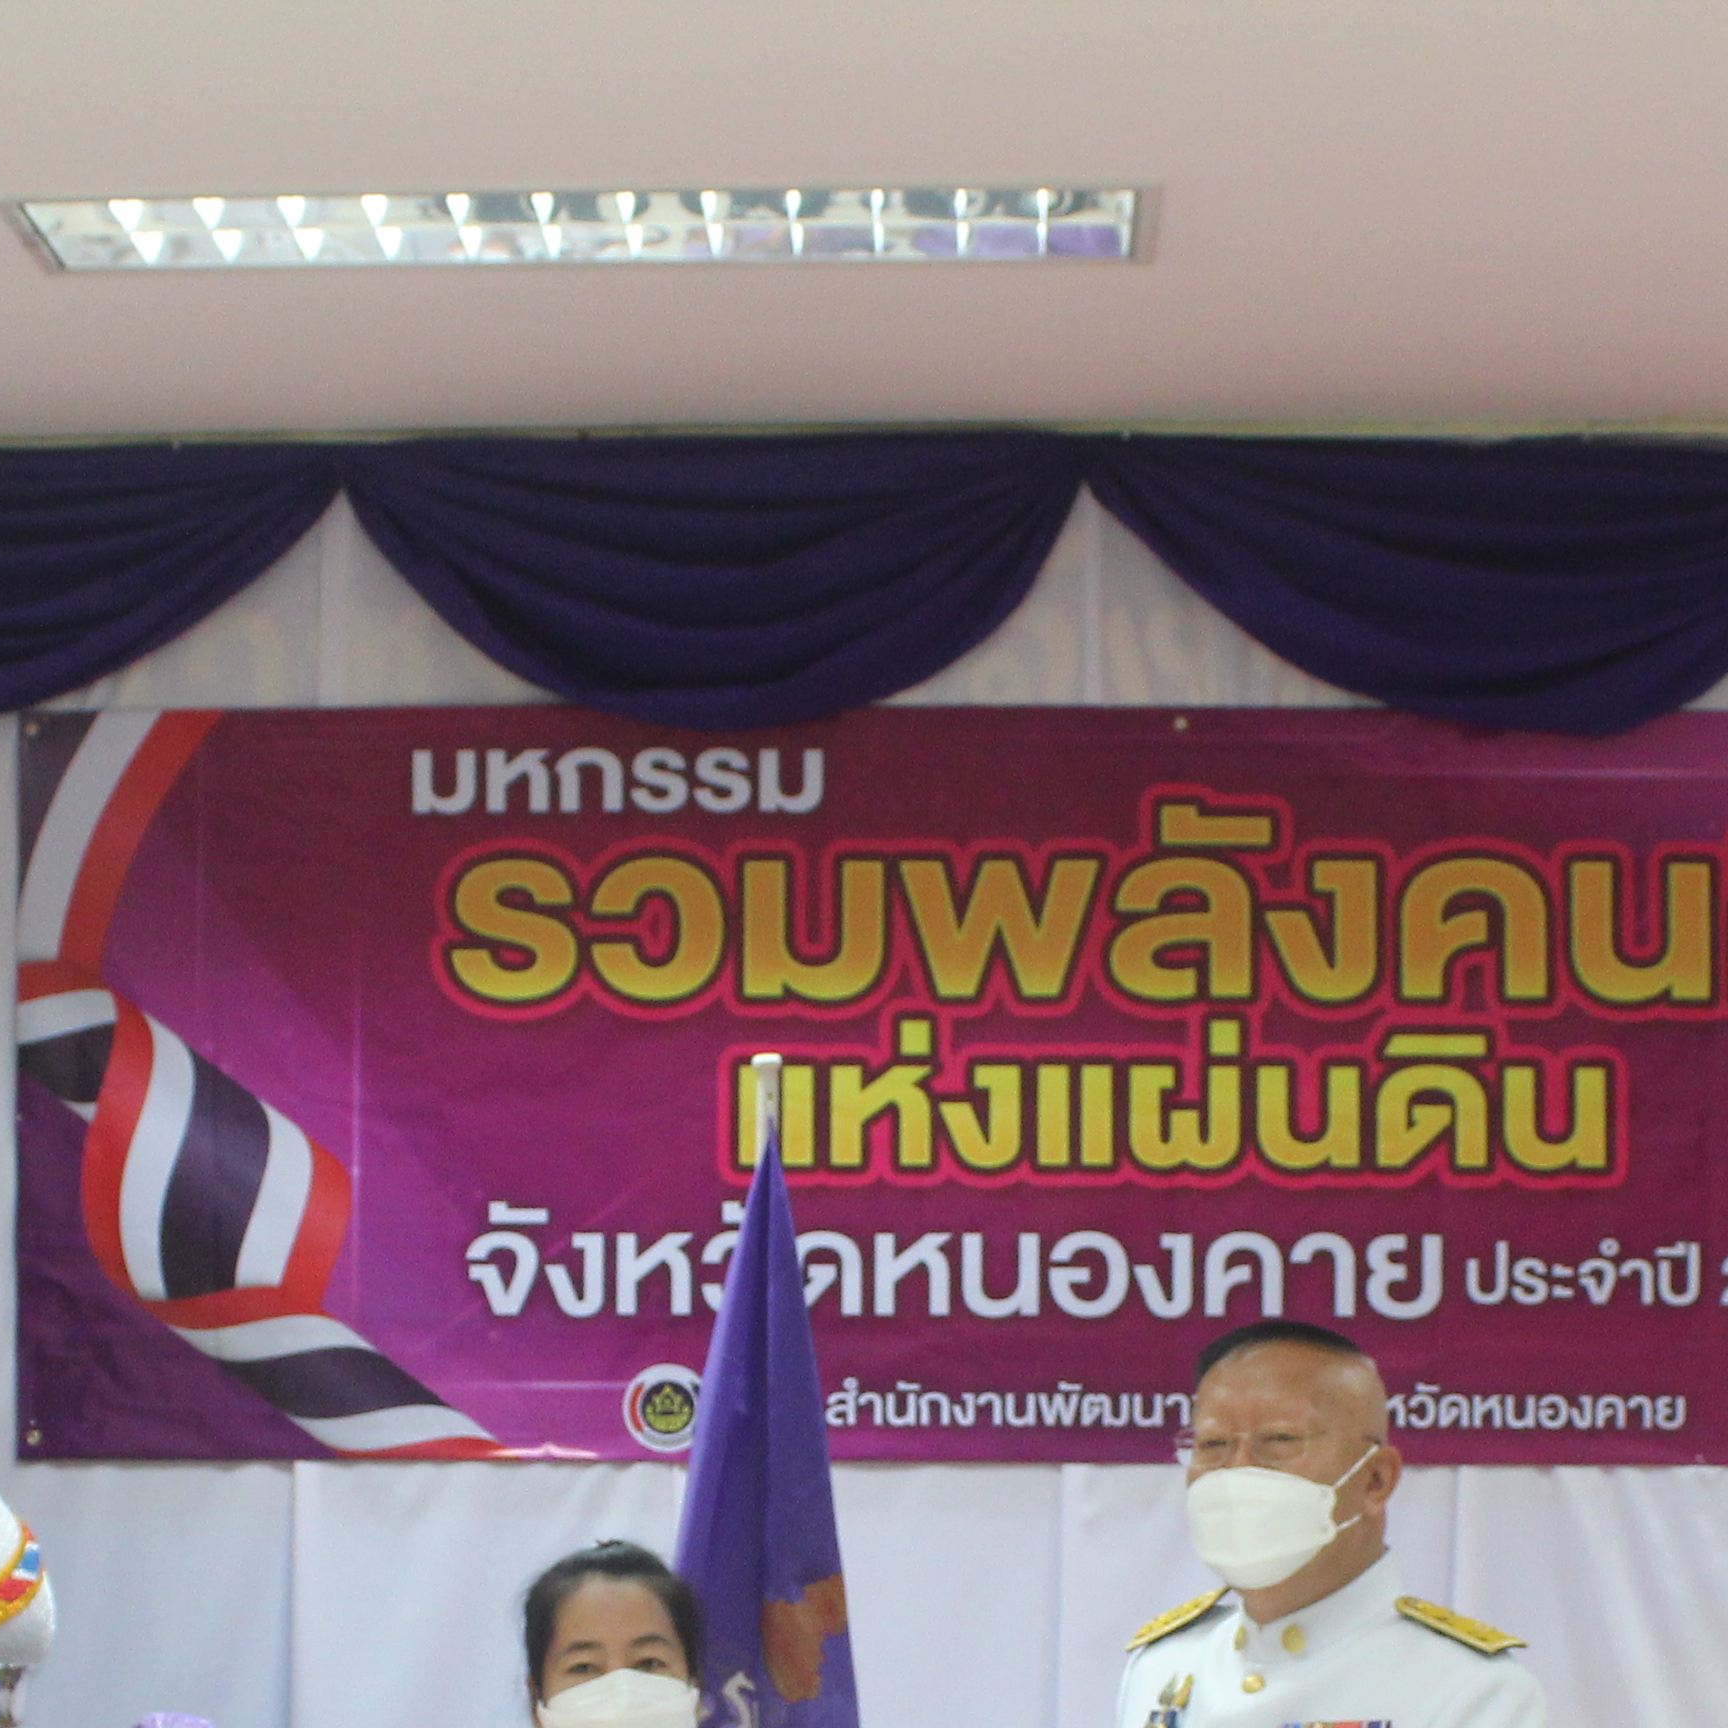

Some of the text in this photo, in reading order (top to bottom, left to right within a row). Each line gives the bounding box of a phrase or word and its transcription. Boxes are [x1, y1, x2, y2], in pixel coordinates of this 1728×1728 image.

[410, 747, 826, 815] มหกรรม
[735, 1016, 1610, 1172] แห่งแผ่นดิน
[1464, 1236, 1703, 1307] ประจำปี
[824, 1376, 1198, 1428] สำนักงานพัฒนา
